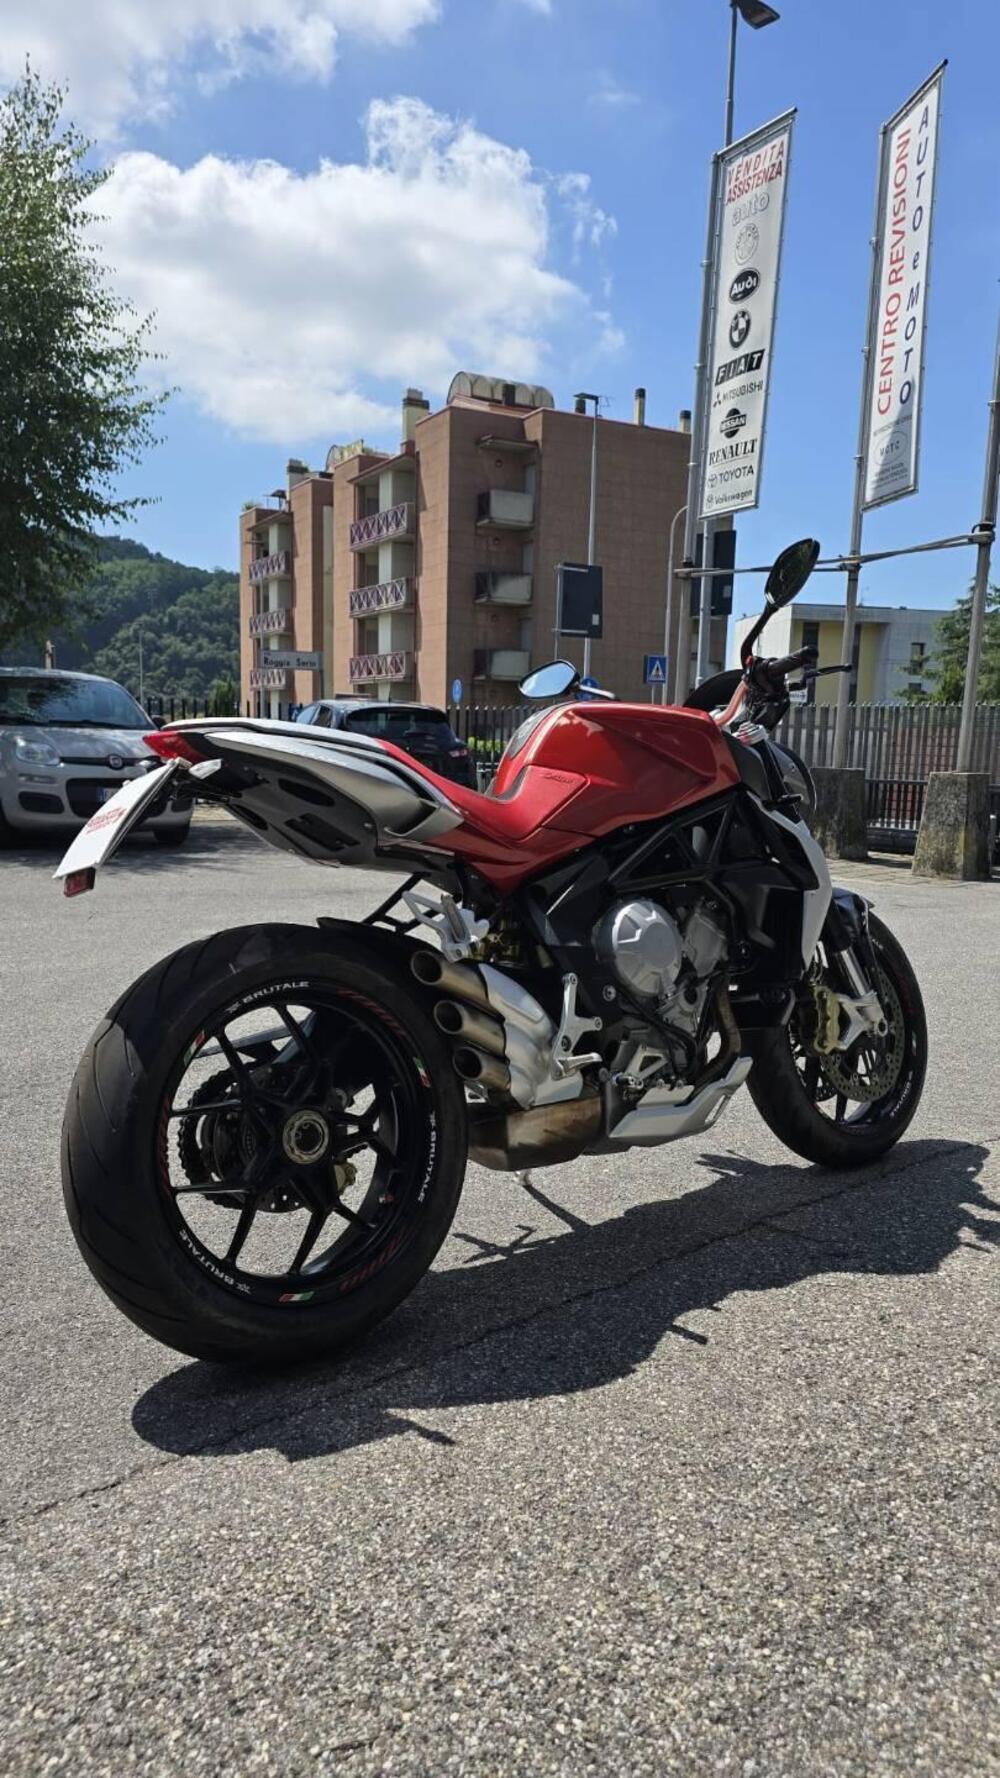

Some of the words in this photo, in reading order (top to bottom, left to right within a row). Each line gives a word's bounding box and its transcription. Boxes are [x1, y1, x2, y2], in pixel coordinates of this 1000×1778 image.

[725, 160, 782, 206] ASSISTENZA
[727, 140, 784, 186] VENDITA
[912, 105, 929, 232] AUTO
[888, 128, 911, 285] REVISIONI
[912, 251, 920, 270] e
[877, 292, 901, 415] CENTRO
[899, 281, 920, 405] MOTO
[717, 351, 763, 383] FIAT
[721, 380, 764, 402] MITSUBISHI
[709, 438, 757, 466] RENAULT
[719, 465, 754, 484] TOYOTA
[714, 490, 752, 504] Volkswagen
[243, 981, 309, 1003] BRUTALE
[418, 1131, 436, 1203] BRUTALE
[179, 1229, 235, 1286] BRUTALE
